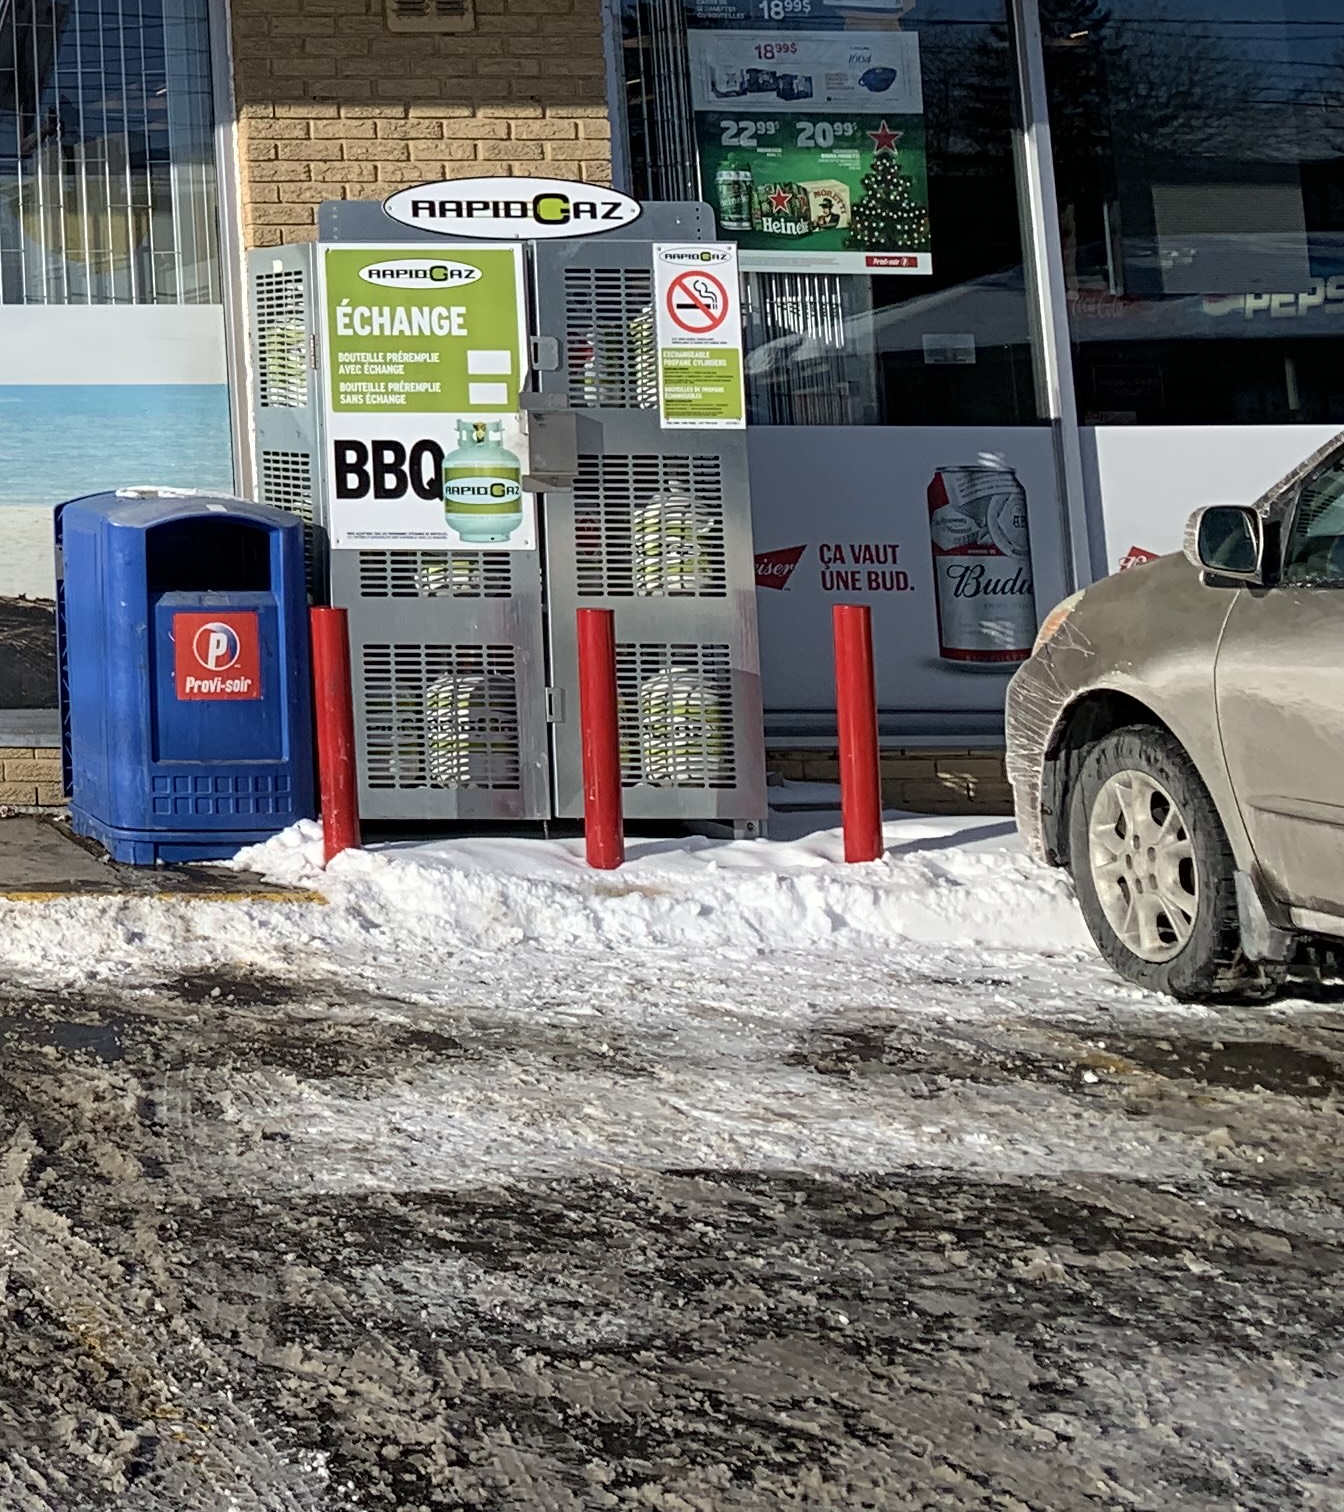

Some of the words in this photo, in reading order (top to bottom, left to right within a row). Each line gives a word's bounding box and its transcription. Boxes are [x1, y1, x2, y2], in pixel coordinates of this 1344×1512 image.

[335, 298, 468, 336] ÉCHANGE
[338, 352, 384, 363] BOUTEILLE
[386, 350, 440, 363] PRÉREMPLIE
[338, 364, 362, 375] AVEC
[363, 362, 405, 375] ÉCHANGE
[339, 381, 385, 392] BOUTEILLE
[388, 379, 441, 393] PRÉREMPLIE
[340, 394, 364, 405] SANS
[365, 392, 407, 405] ÉCHANGE
[333, 439, 446, 502] BBQ
[819, 544, 844, 569] ÇA
[850, 544, 900, 565] VAUT
[822, 571, 863, 591] UNE
[868, 571, 915, 591] BUD.
